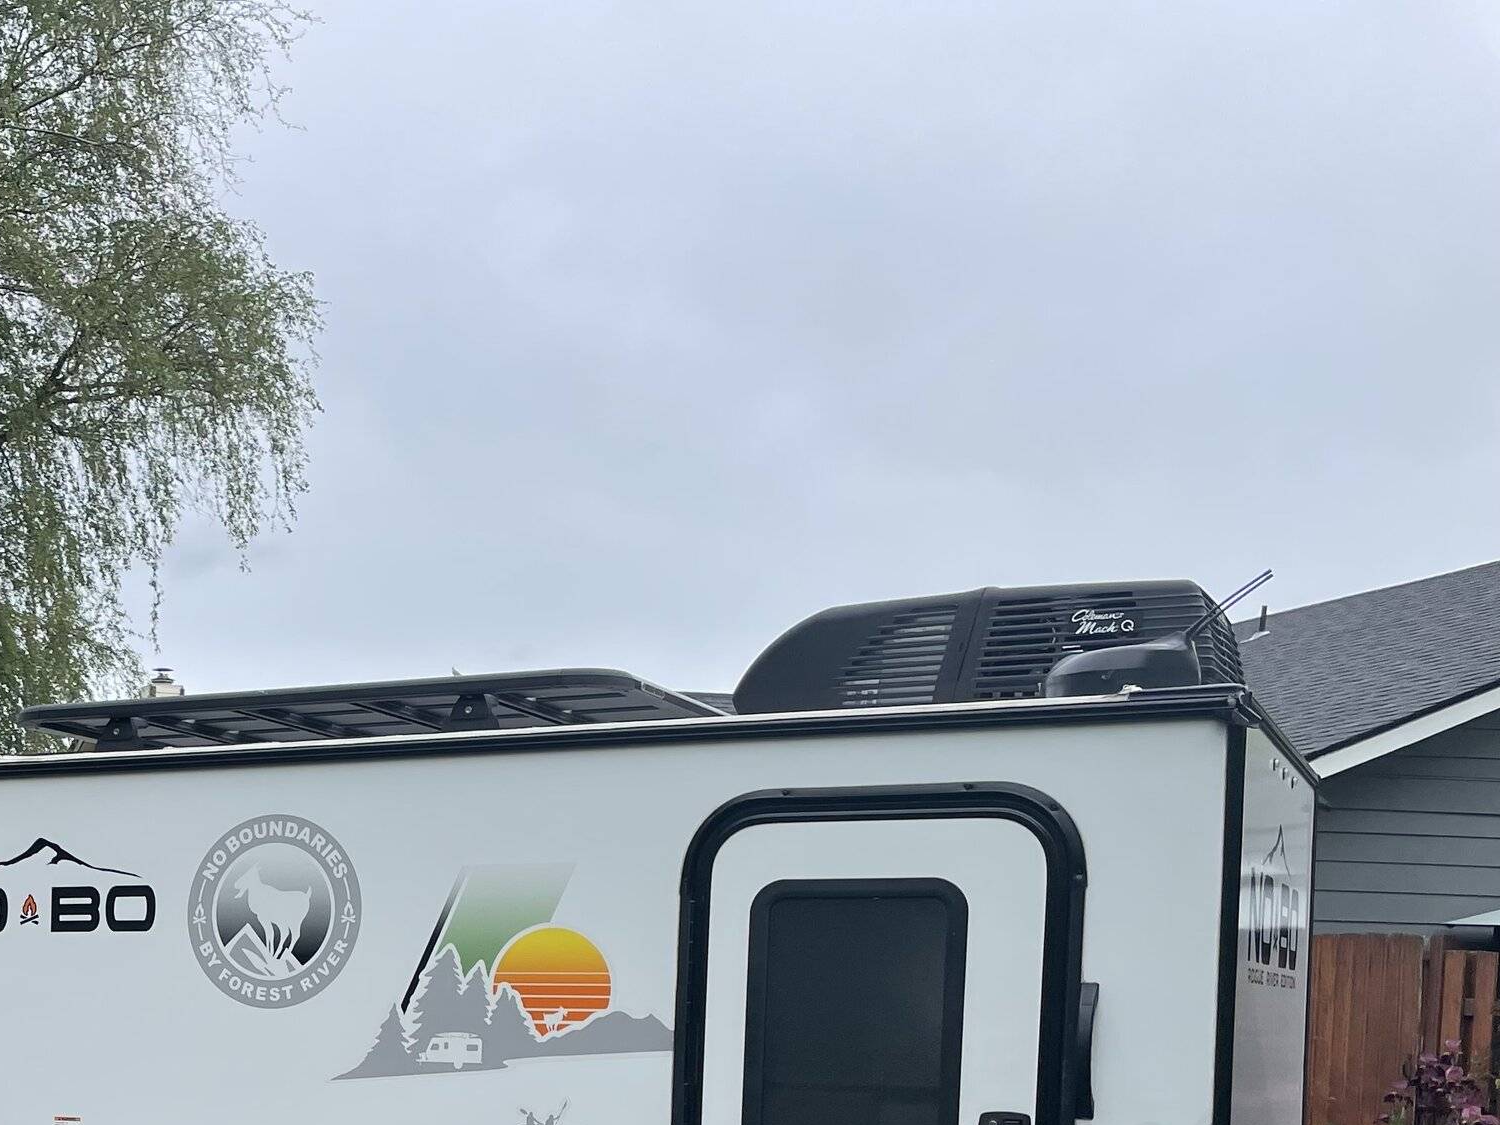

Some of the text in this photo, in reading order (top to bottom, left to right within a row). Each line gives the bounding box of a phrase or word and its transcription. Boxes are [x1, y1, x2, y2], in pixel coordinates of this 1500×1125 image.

[1075, 619, 1134, 634] Mach Q
[202, 821, 348, 881] NO BOUNDARIES
[51, 885, 156, 932] BO
[200, 939, 348, 1001] BY FOREST RIVER
